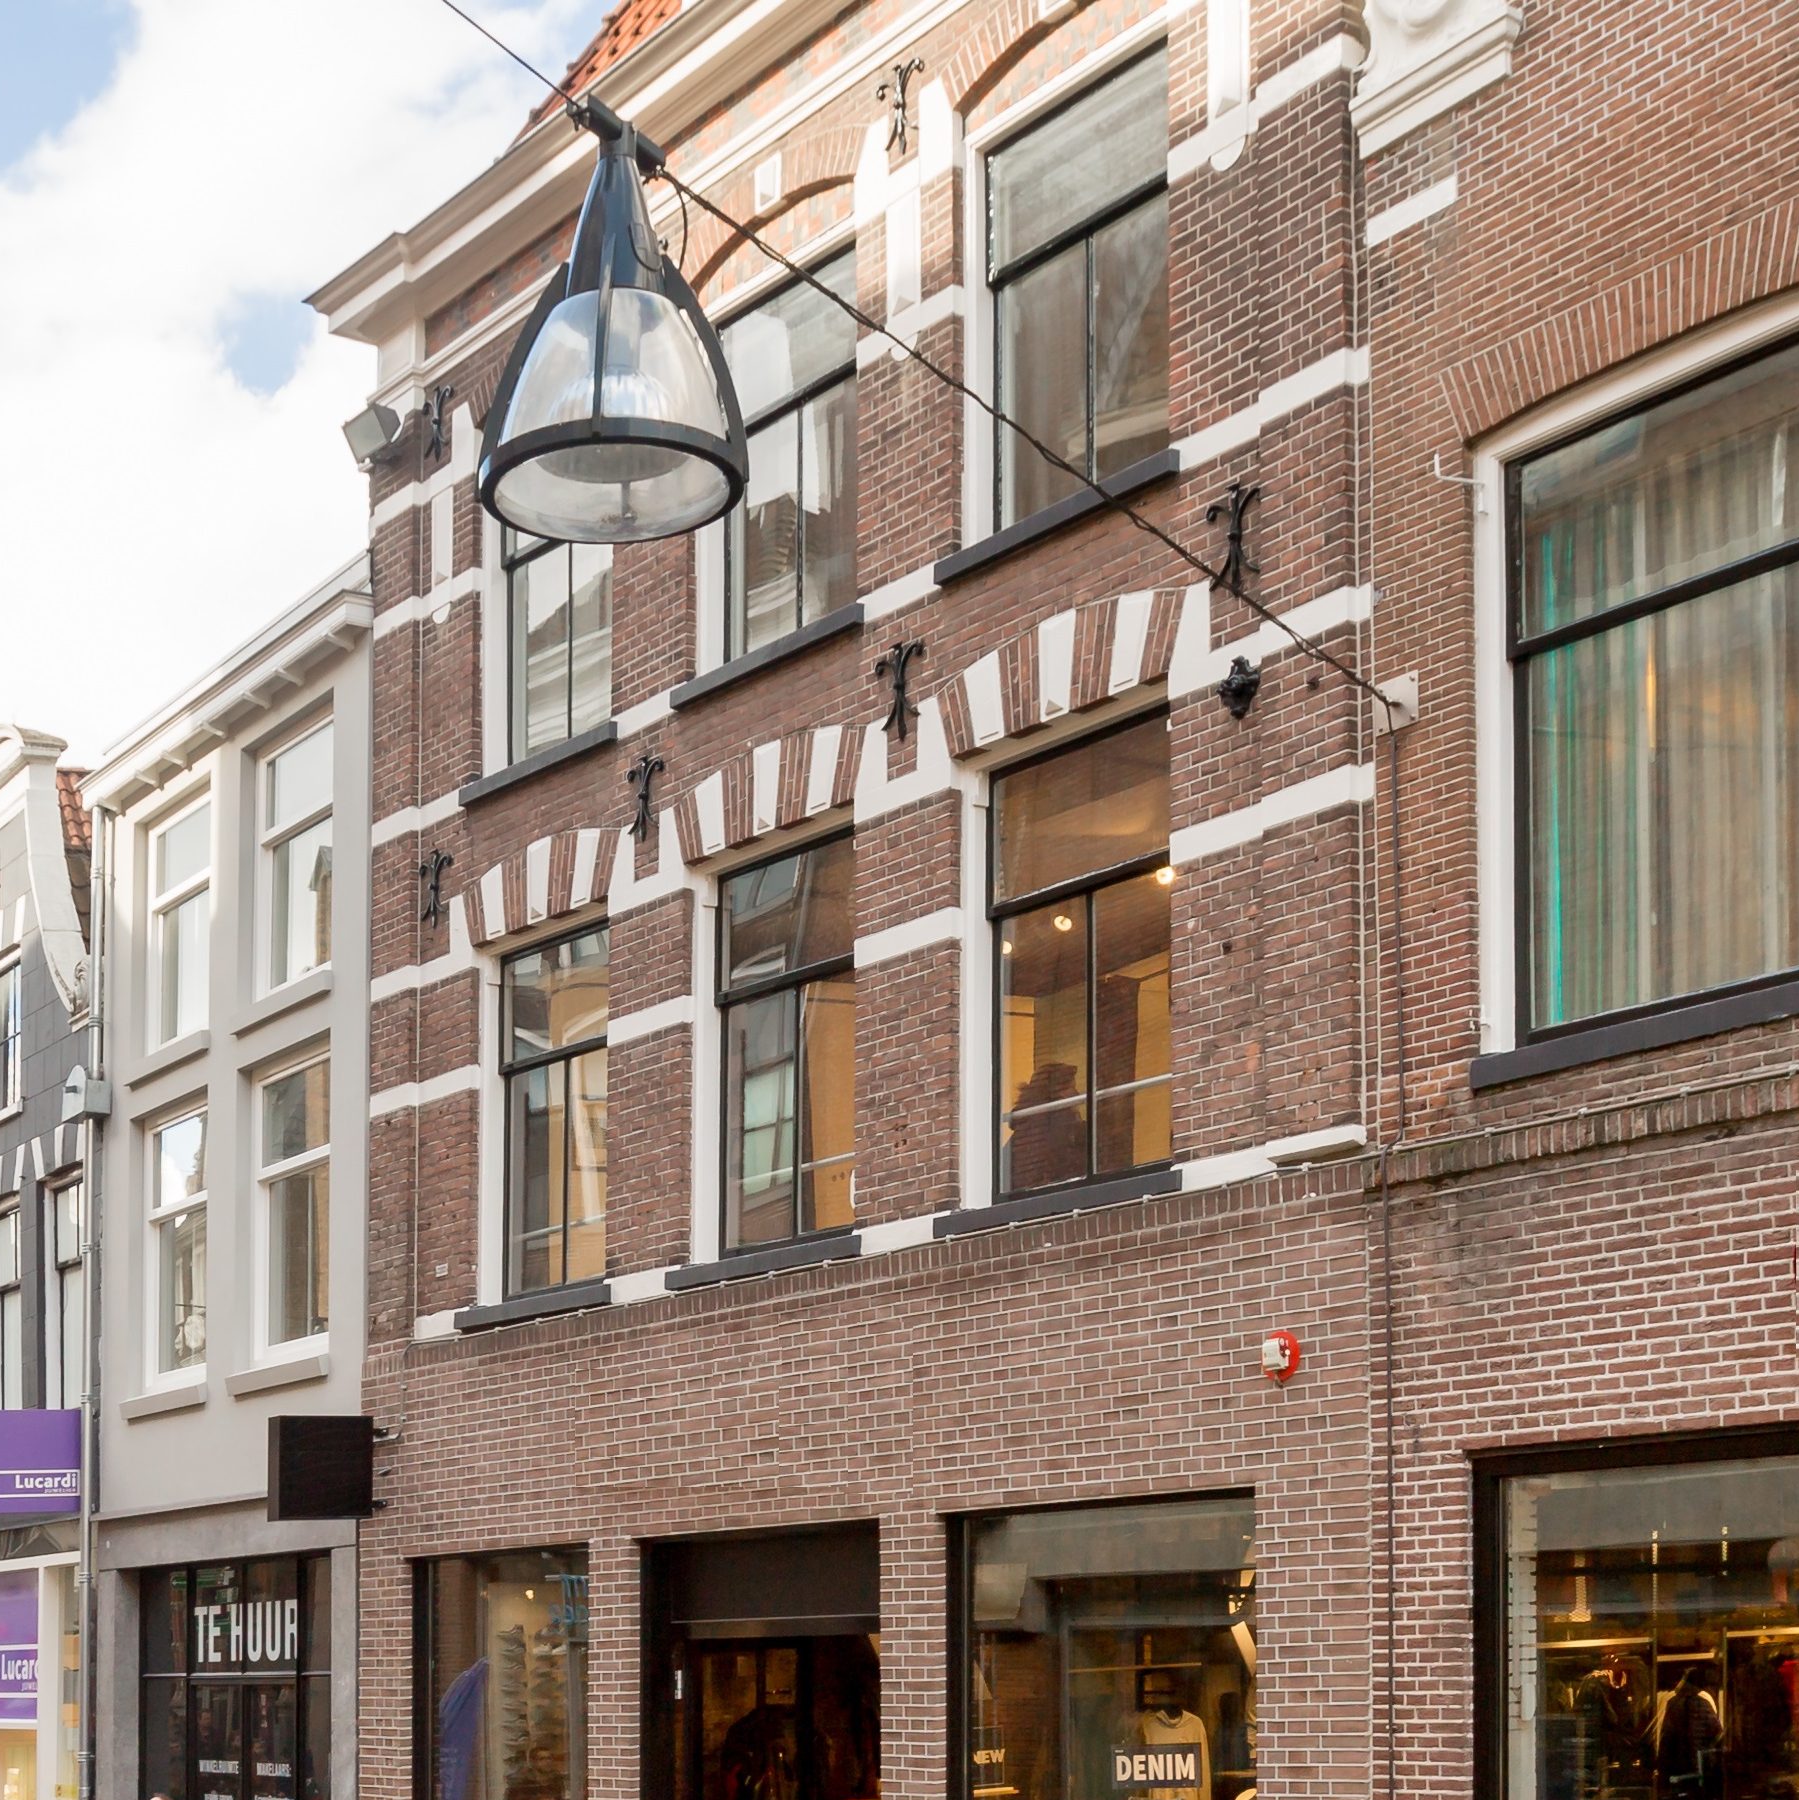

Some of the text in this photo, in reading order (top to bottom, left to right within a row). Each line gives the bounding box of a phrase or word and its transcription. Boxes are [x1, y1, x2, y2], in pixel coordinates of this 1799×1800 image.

[15, 1473, 76, 1489] Lucardi
[194, 1599, 298, 1663] TE HUUR
[1116, 1753, 1196, 1782] DENIM
